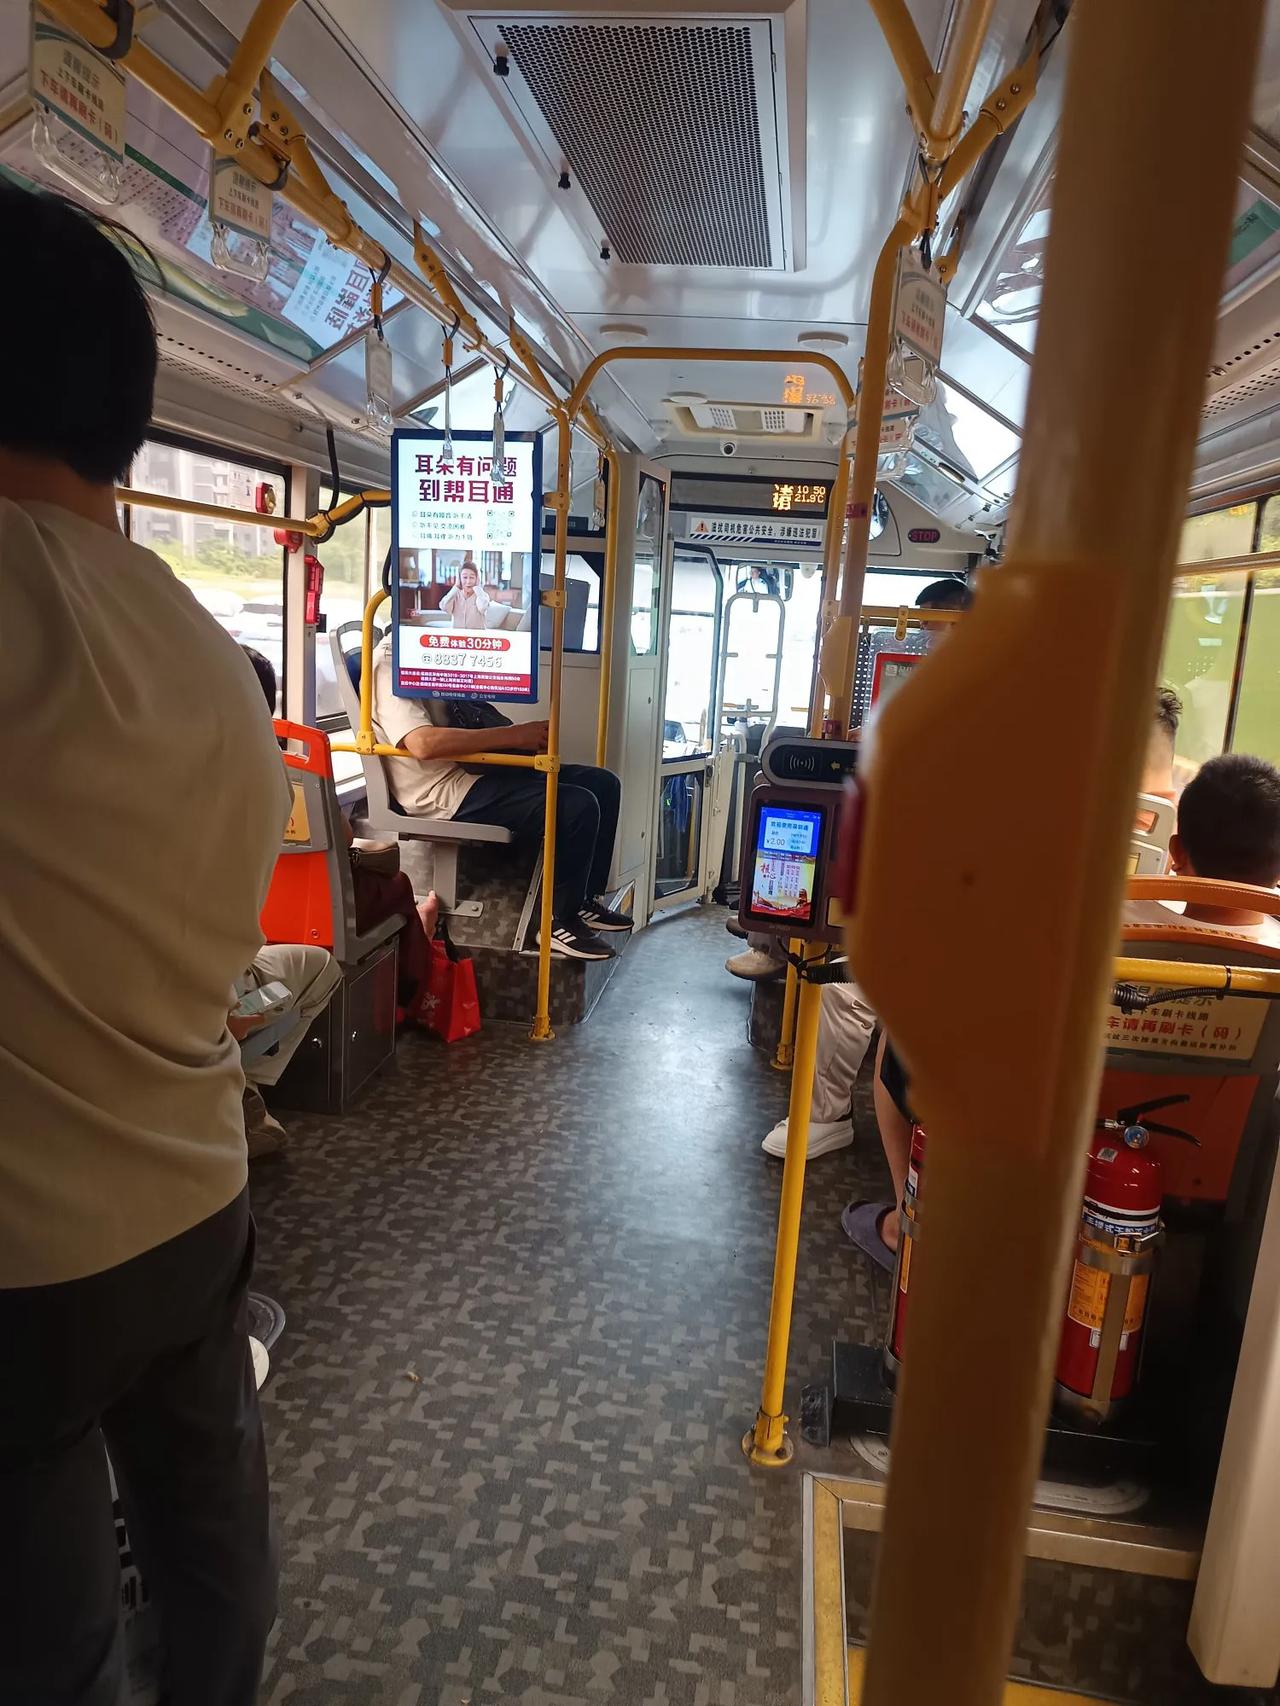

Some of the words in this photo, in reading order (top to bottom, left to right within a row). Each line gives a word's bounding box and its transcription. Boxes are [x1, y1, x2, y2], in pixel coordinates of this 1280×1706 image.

[911, 531, 938, 542] STOP
[434, 653, 466, 666] 8837
[470, 655, 503, 668] 7456
